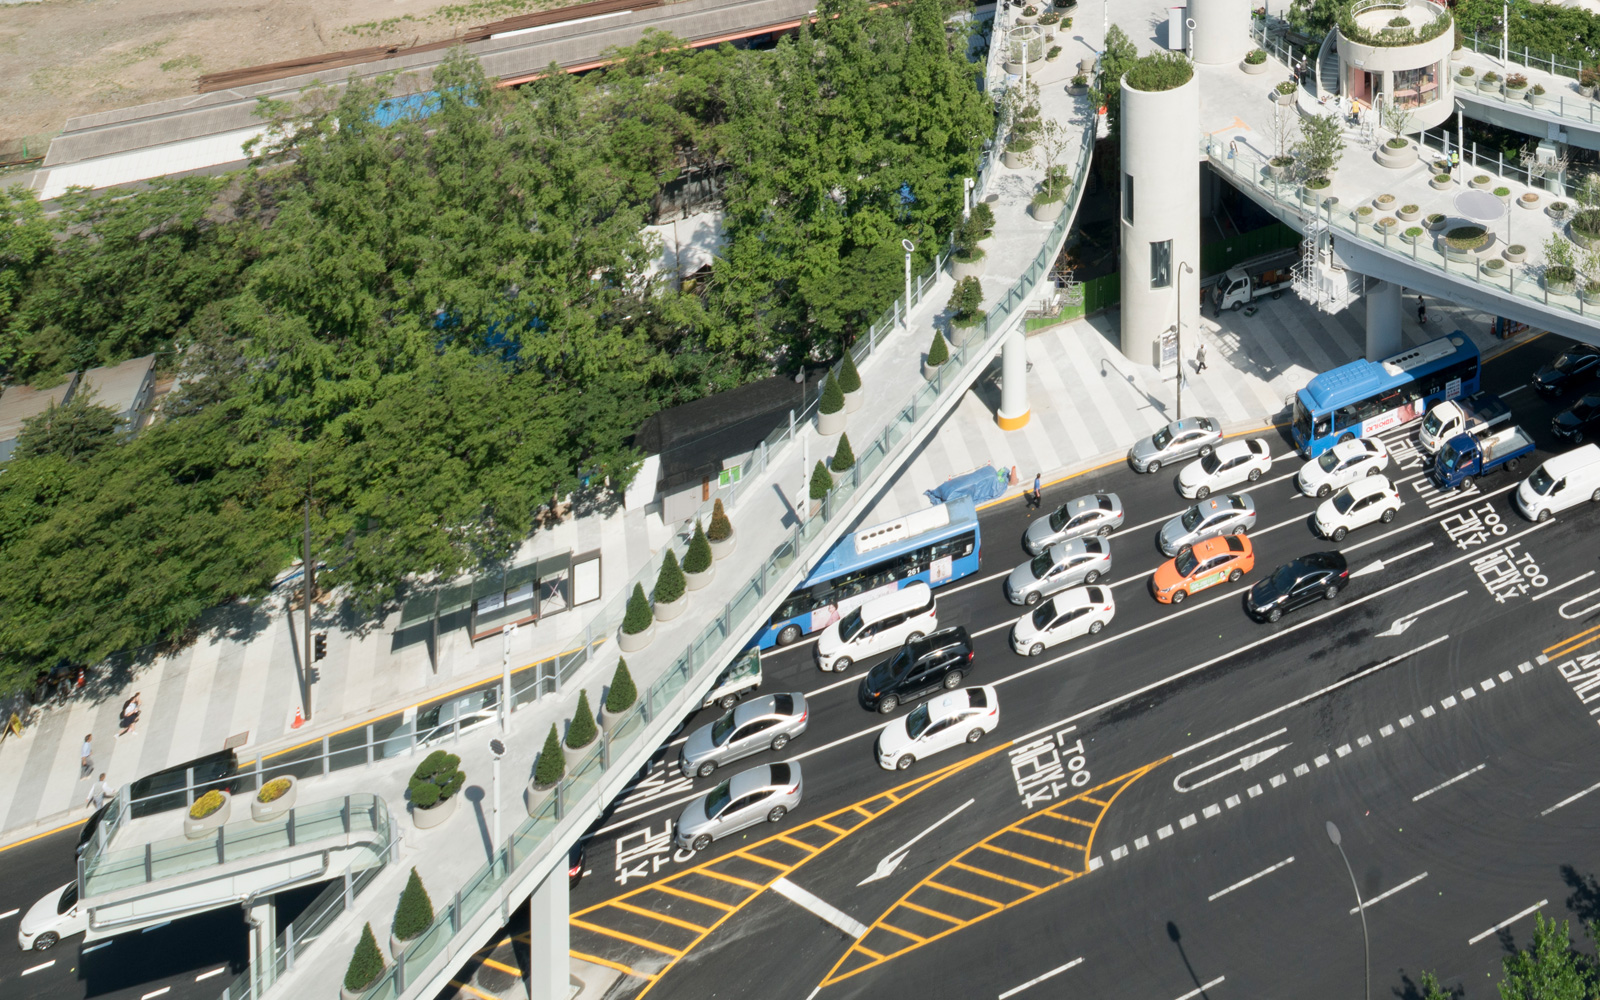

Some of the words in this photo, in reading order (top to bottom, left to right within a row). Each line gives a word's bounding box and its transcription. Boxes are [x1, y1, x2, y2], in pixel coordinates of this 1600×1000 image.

[1429, 385, 1440, 395] 173
[1440, 503, 1508, 550] 충정로
[907, 567, 920, 577] 261
[1470, 542, 1549, 603] 충정로역
[1008, 725, 1091, 809] 충정로역
